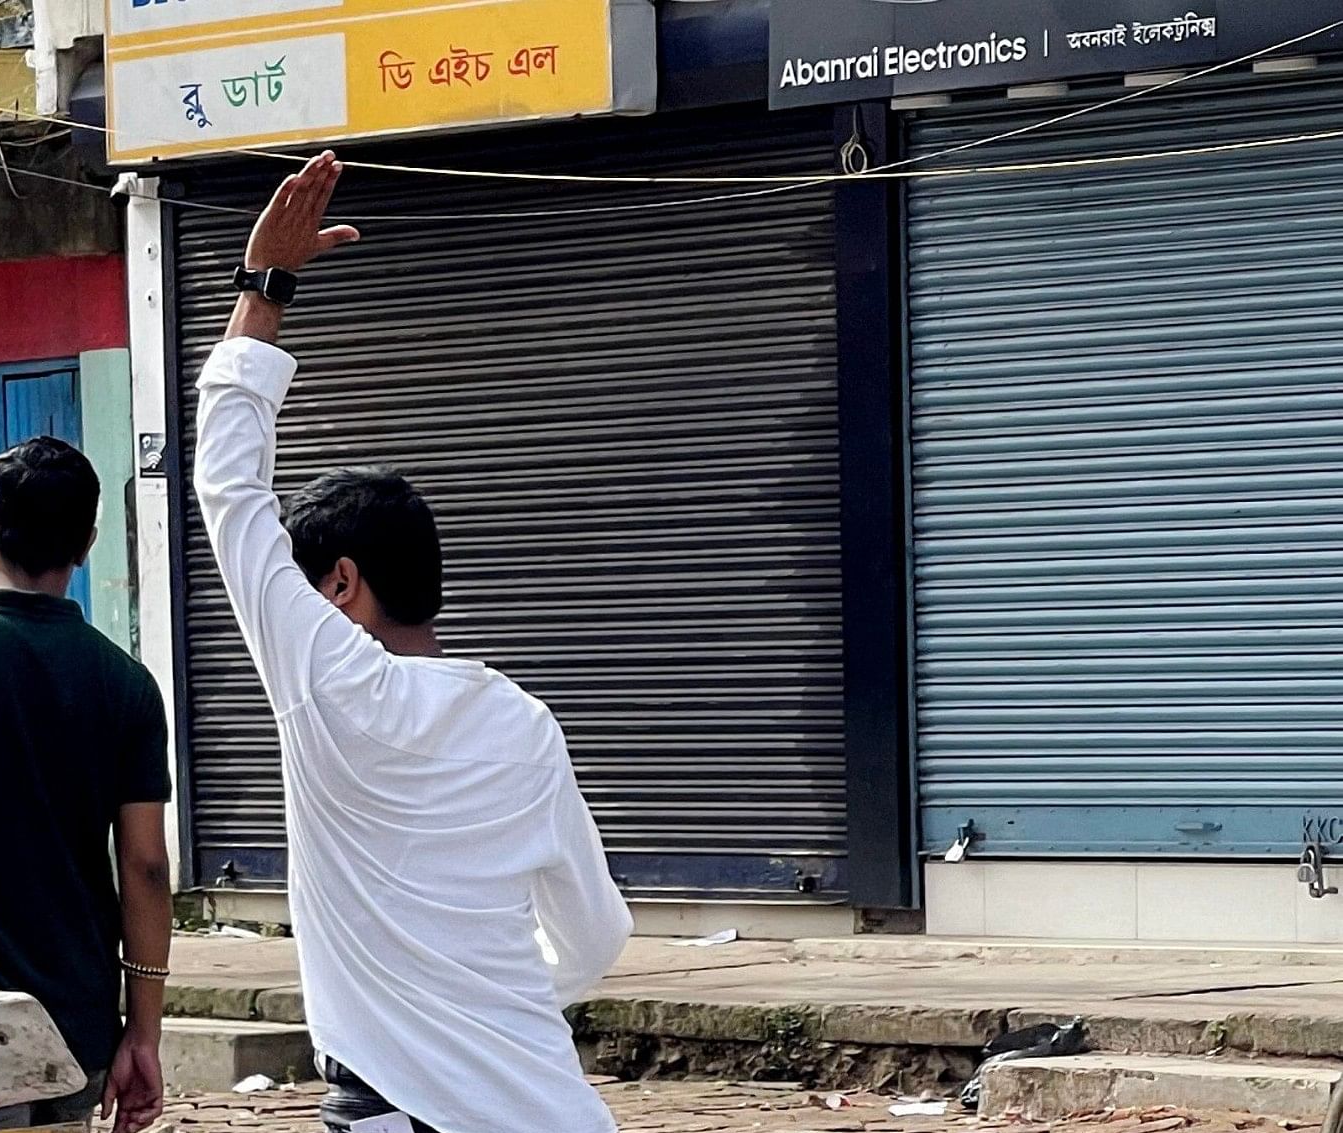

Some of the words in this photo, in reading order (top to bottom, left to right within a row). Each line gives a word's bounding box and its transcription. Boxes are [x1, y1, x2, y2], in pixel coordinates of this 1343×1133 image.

[220, 54, 287, 107] ডার্ট
[377, 50, 413, 94] ডি
[427, 43, 495, 88] এইচ
[506, 43, 560, 78] এল
[779, 45, 879, 90] Abanrai
[883, 32, 1027, 76] Electronics
